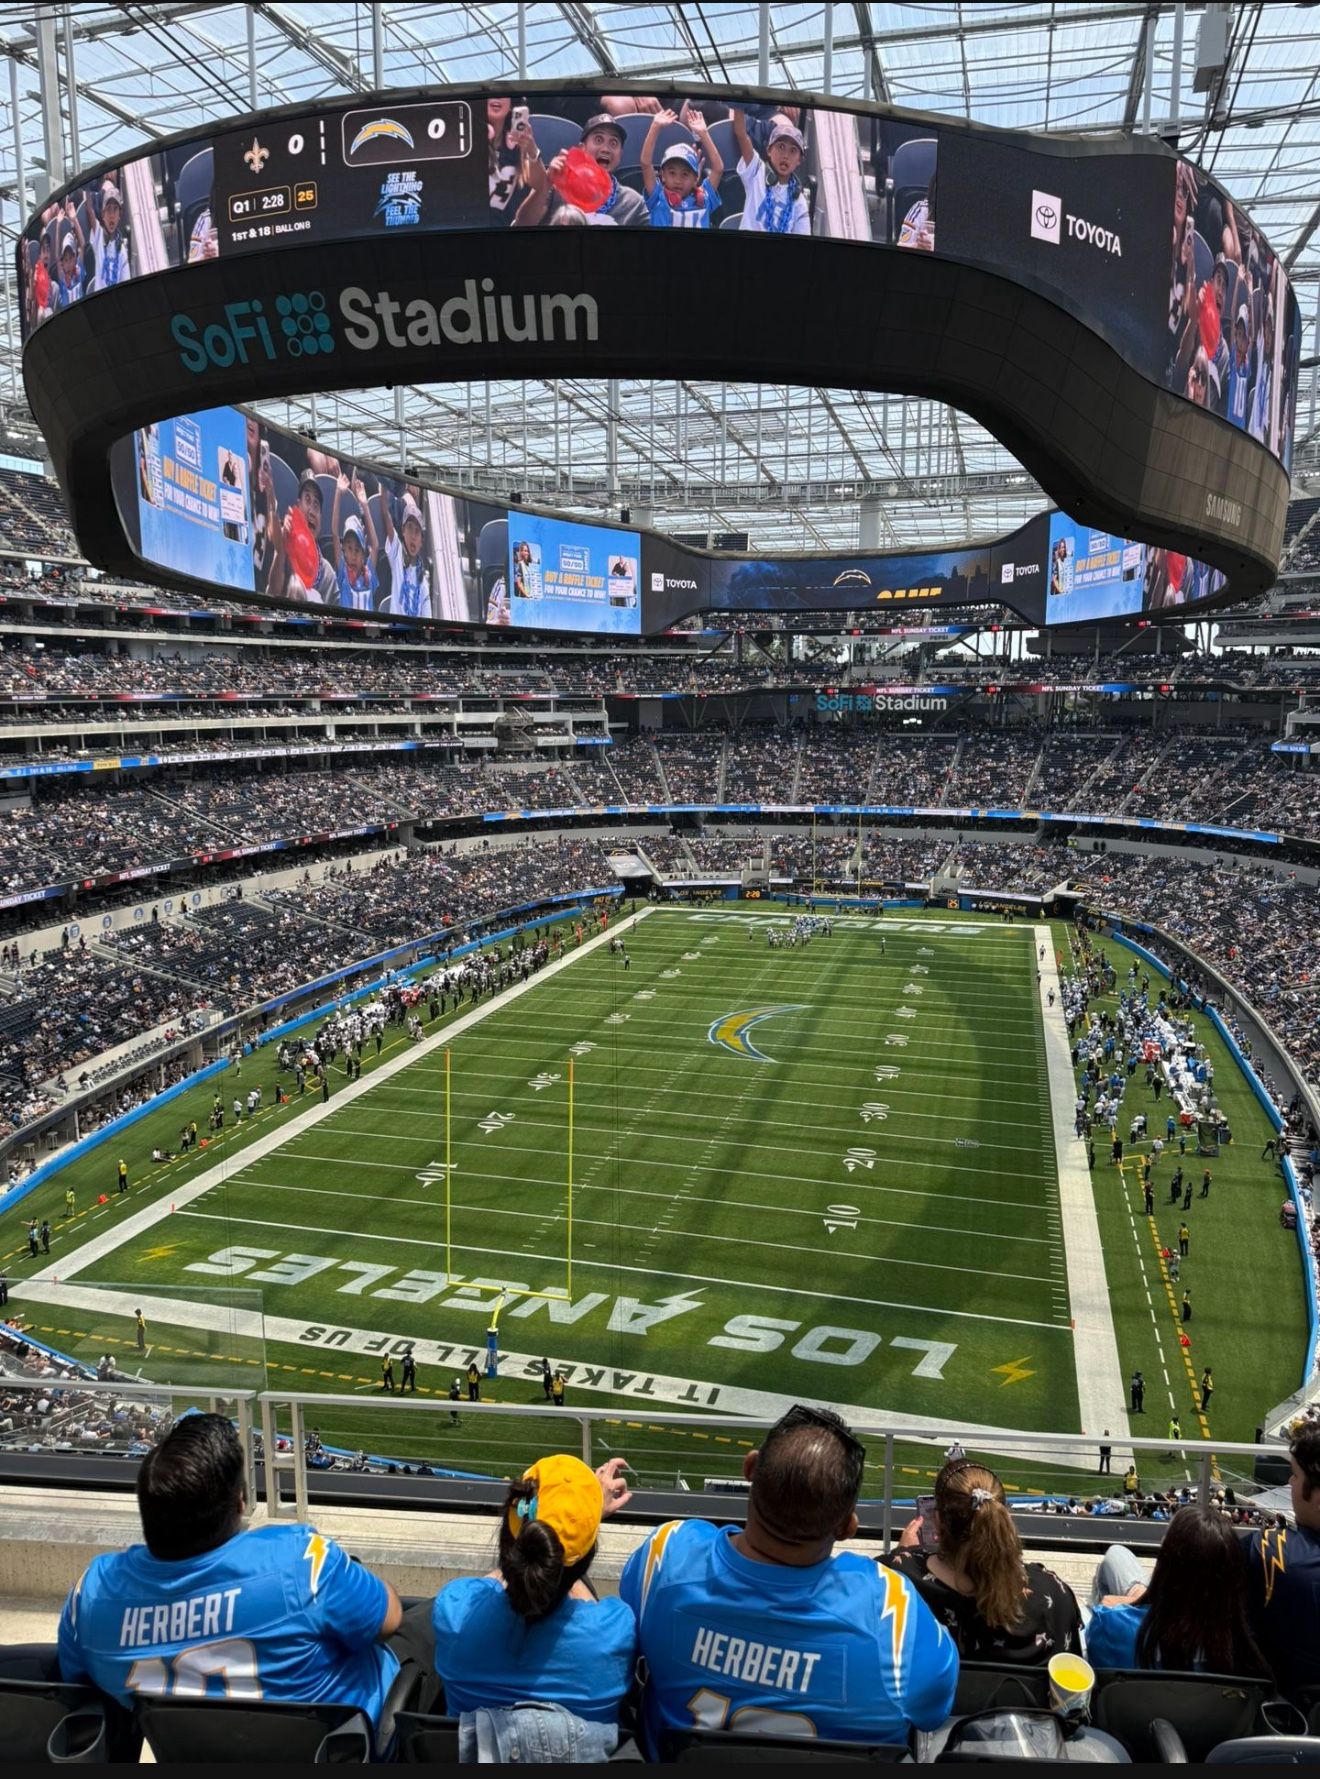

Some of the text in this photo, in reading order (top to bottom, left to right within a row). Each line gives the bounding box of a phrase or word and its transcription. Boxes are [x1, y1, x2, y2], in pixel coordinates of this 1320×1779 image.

[427, 118, 446, 139] 0
[288, 134, 304, 154] 0
[381, 181, 423, 194] LIGHTNING
[387, 171, 417, 183] SEE THE
[233, 190, 314, 214] Q1 2:28 25
[232, 231, 248, 242] 1ST
[249, 228, 257, 238] &
[259, 226, 271, 237] 18
[275, 225, 290, 235] BALL
[291, 222, 304, 231] ON
[1066, 214, 1121, 256] TOYOTA
[171, 277, 599, 373] SoFi Stadium
[1205, 493, 1241, 526] SAMSUNG
[1015, 563, 1040, 577] TOYOTA
[665, 578, 697, 589] TOYOTA
[817, 694, 947, 711] SoFi Stadium
[131, 868, 152, 878] SUNDAY
[153, 863, 171, 873] TICKET
[0, 890, 46, 908] UNDAY TICKET
[686, 914, 985, 935] CHAGERS
[477, 1111, 516, 1131] 20
[860, 1102, 890, 1120] 30
[843, 1147, 877, 1169] 20
[415, 1161, 458, 1182] 10
[823, 1204, 861, 1230] 10
[183, 1246, 958, 1380] LOS ANGELES
[300, 1326, 354, 1346] US
[364, 1336, 416, 1356] OF
[524, 1359, 656, 1395] TAKES
[678, 1384, 721, 1405] IT
[120, 1588, 242, 1647] HERBERT
[691, 1627, 822, 1693] HERBERT
